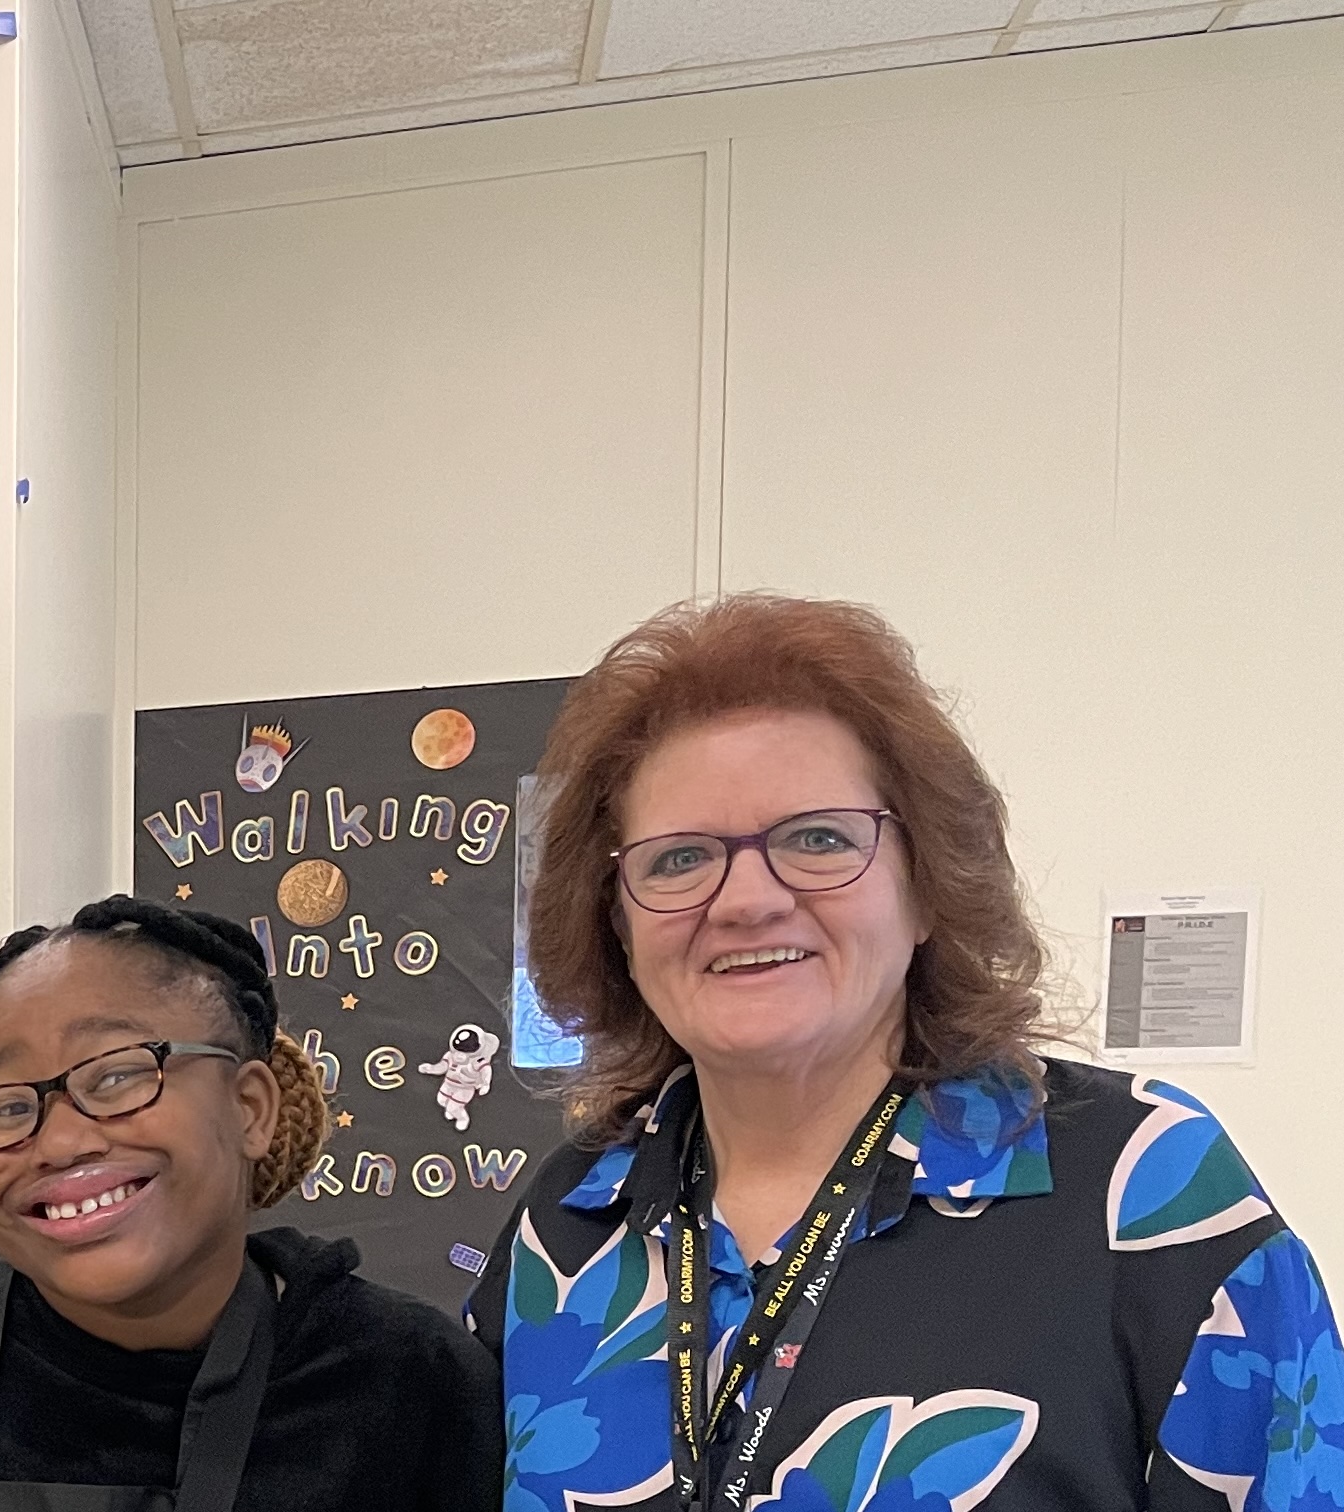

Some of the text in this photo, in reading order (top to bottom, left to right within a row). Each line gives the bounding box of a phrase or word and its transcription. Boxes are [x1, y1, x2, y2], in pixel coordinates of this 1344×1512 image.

[142, 786, 509, 867] Walking
[250, 914, 439, 979] Into
[303, 1029, 407, 1095] he
[851, 1093, 904, 1168] GOARMY.COM
[300, 1143, 527, 1201] know
[763, 1210, 832, 1319] BE ALL YOU CAN BE
[802, 1270, 831, 1307] Ms.
[678, 1348, 691, 1368] BE
[681, 1368, 692, 1395] CAN
[724, 1406, 773, 1509] Ms. Woods
